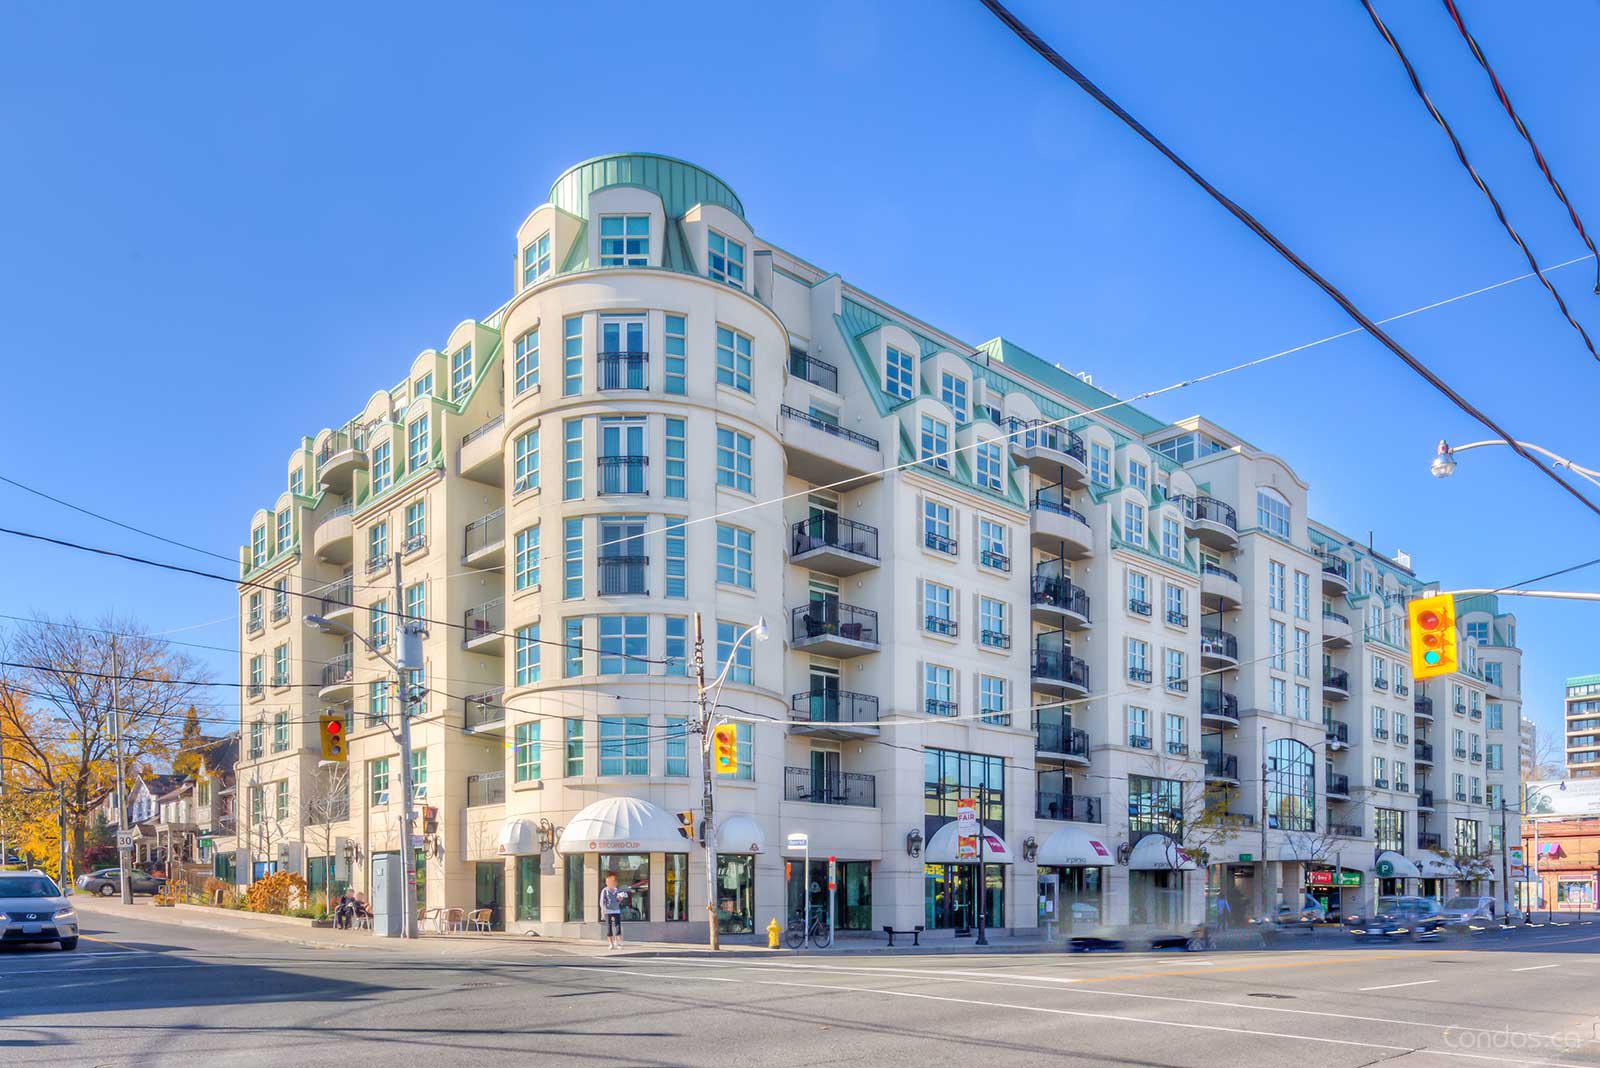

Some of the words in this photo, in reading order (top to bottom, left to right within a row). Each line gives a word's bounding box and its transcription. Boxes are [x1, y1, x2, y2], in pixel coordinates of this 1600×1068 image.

[958, 813, 975, 821] FAIR
[120, 837, 131, 845] 30
[1381, 864, 1389, 873] P
